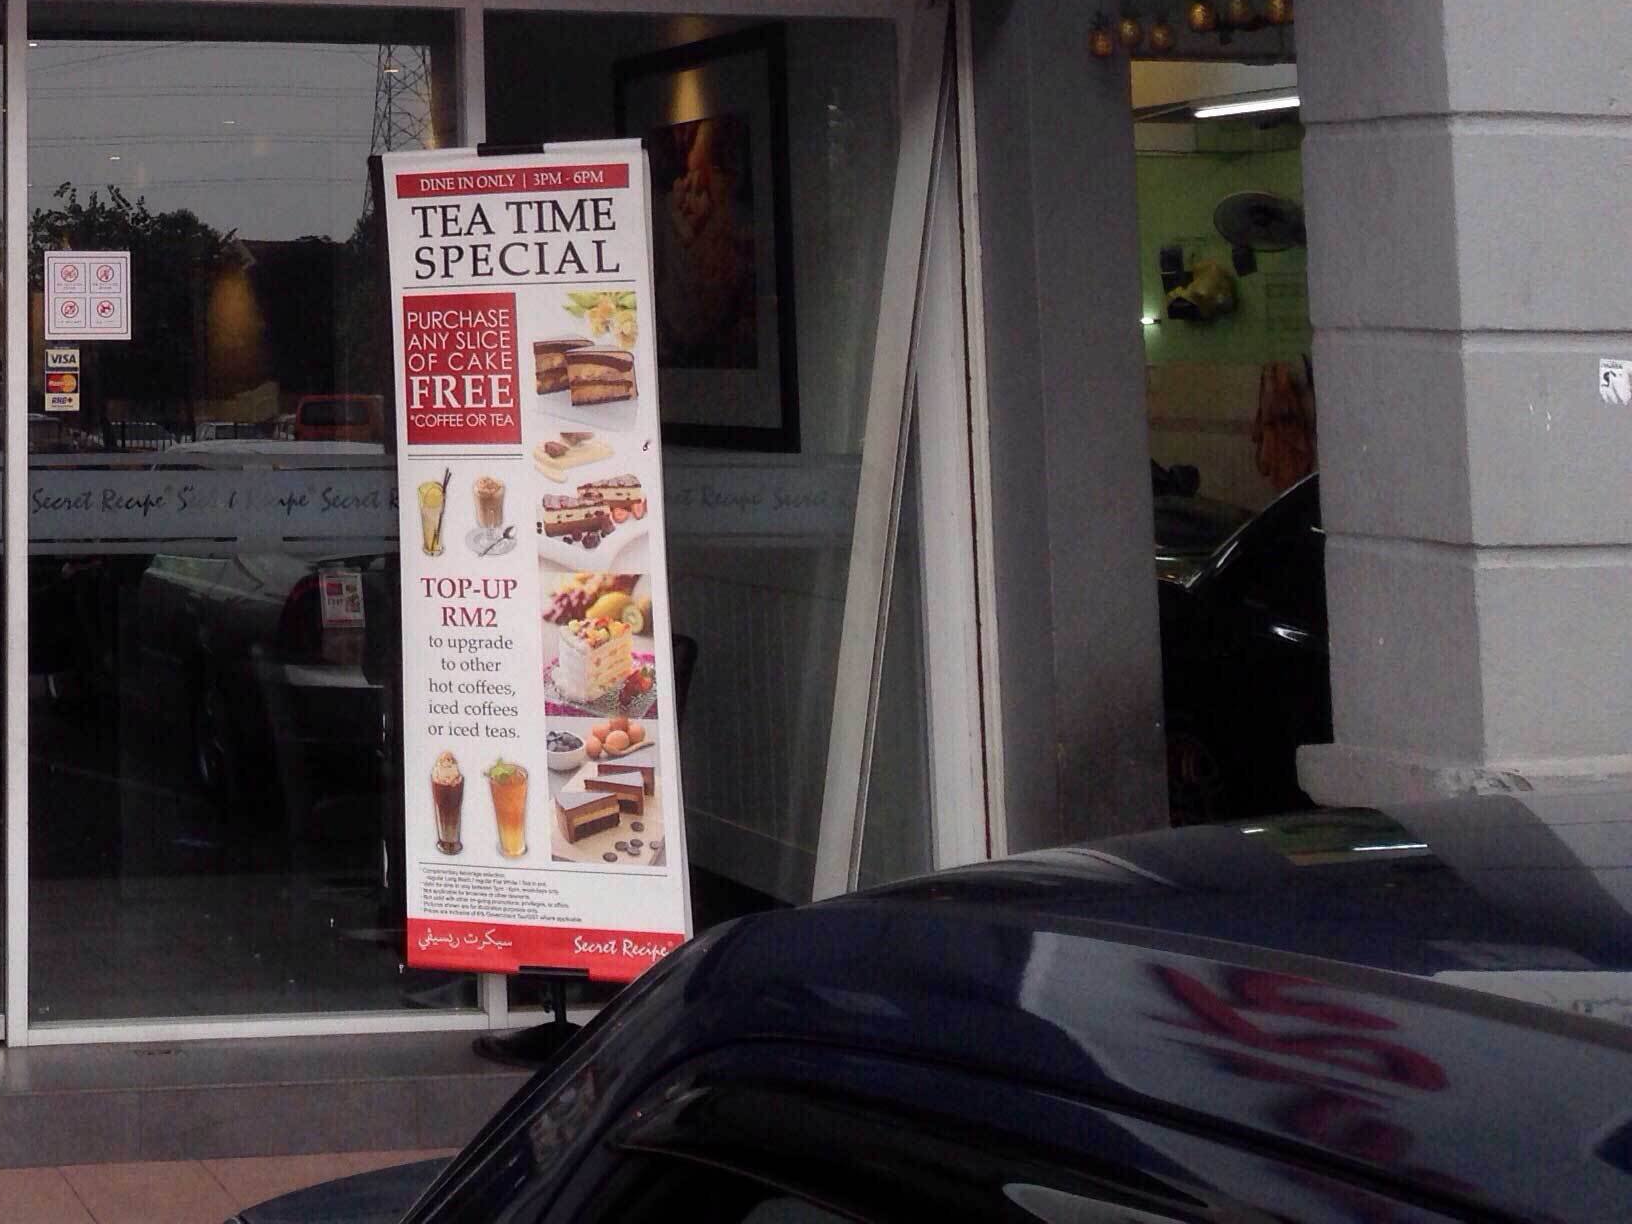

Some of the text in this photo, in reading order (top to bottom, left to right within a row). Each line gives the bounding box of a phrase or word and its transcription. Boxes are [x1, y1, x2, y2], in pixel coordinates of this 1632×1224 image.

[420, 177, 455, 192] DINE
[459, 176, 474, 190] IN
[477, 174, 516, 188] ONLY
[533, 172, 562, 186] 3PM
[573, 170, 604, 184] 6PM
[412, 198, 616, 238] TEA TIME
[414, 240, 620, 280] SPECIAL
[407, 309, 510, 330] PURCHASE
[407, 330, 511, 351] ANY SLICE
[51, 354, 77, 364] VISA
[408, 351, 513, 372] OF CAKE
[409, 374, 514, 409] FREE
[466, 413, 487, 427] OR
[488, 413, 515, 427] TEA
[32, 487, 92, 514] Secret
[421, 577, 518, 599] TOP-UP
[441, 606, 498, 628] RM2
[428, 635, 514, 653] to upgrade
[441, 657, 502, 672] to other
[428, 678, 517, 697] hot coffees,
[428, 700, 519, 716] iced coffees
[428, 722, 520, 739] or iced teas.
[574, 935, 670, 962] Secret Recipe
